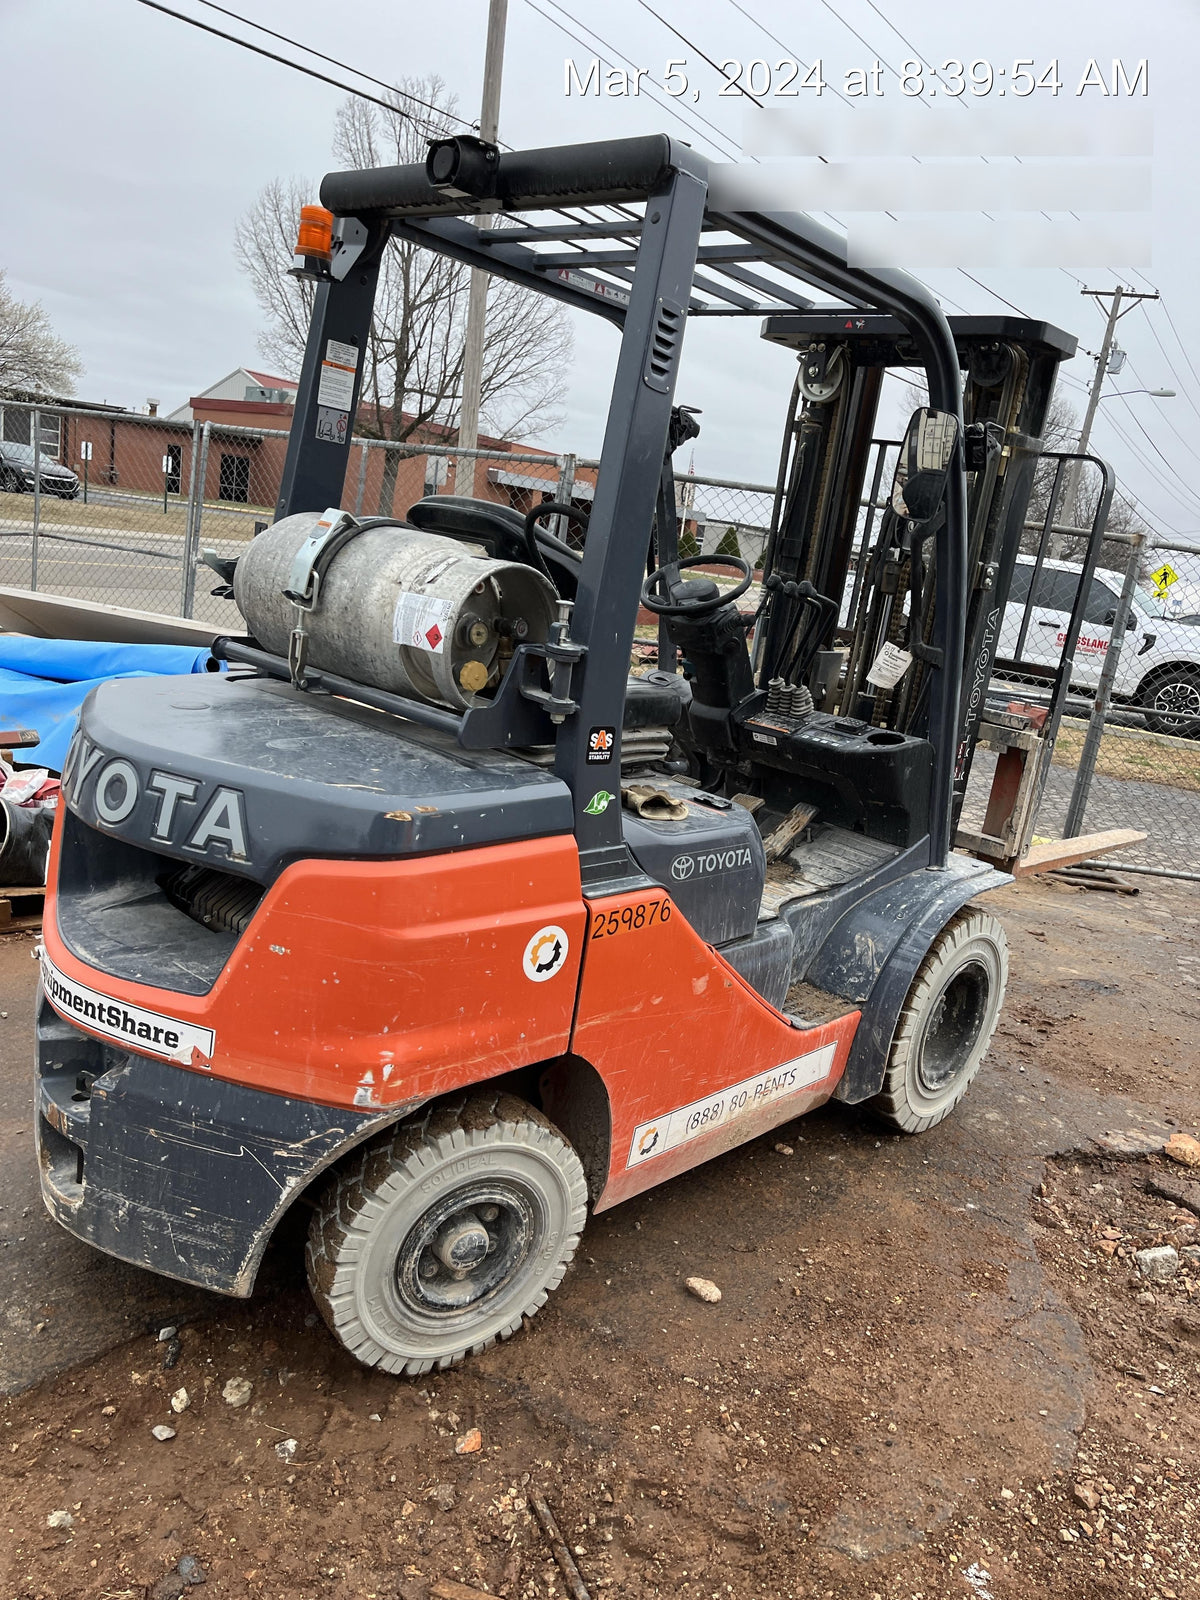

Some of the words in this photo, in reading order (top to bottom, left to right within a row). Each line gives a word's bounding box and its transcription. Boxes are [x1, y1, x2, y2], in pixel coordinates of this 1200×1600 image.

[965, 607, 1000, 727] TOYOTA
[590, 729, 613, 750] SAS
[62, 729, 250, 862] OYOTA
[697, 847, 752, 873] TOYOTA
[592, 898, 671, 940] 259876
[685, 1100, 725, 1134] (888)
[421, 1153, 497, 1194] SOLIDEAL
